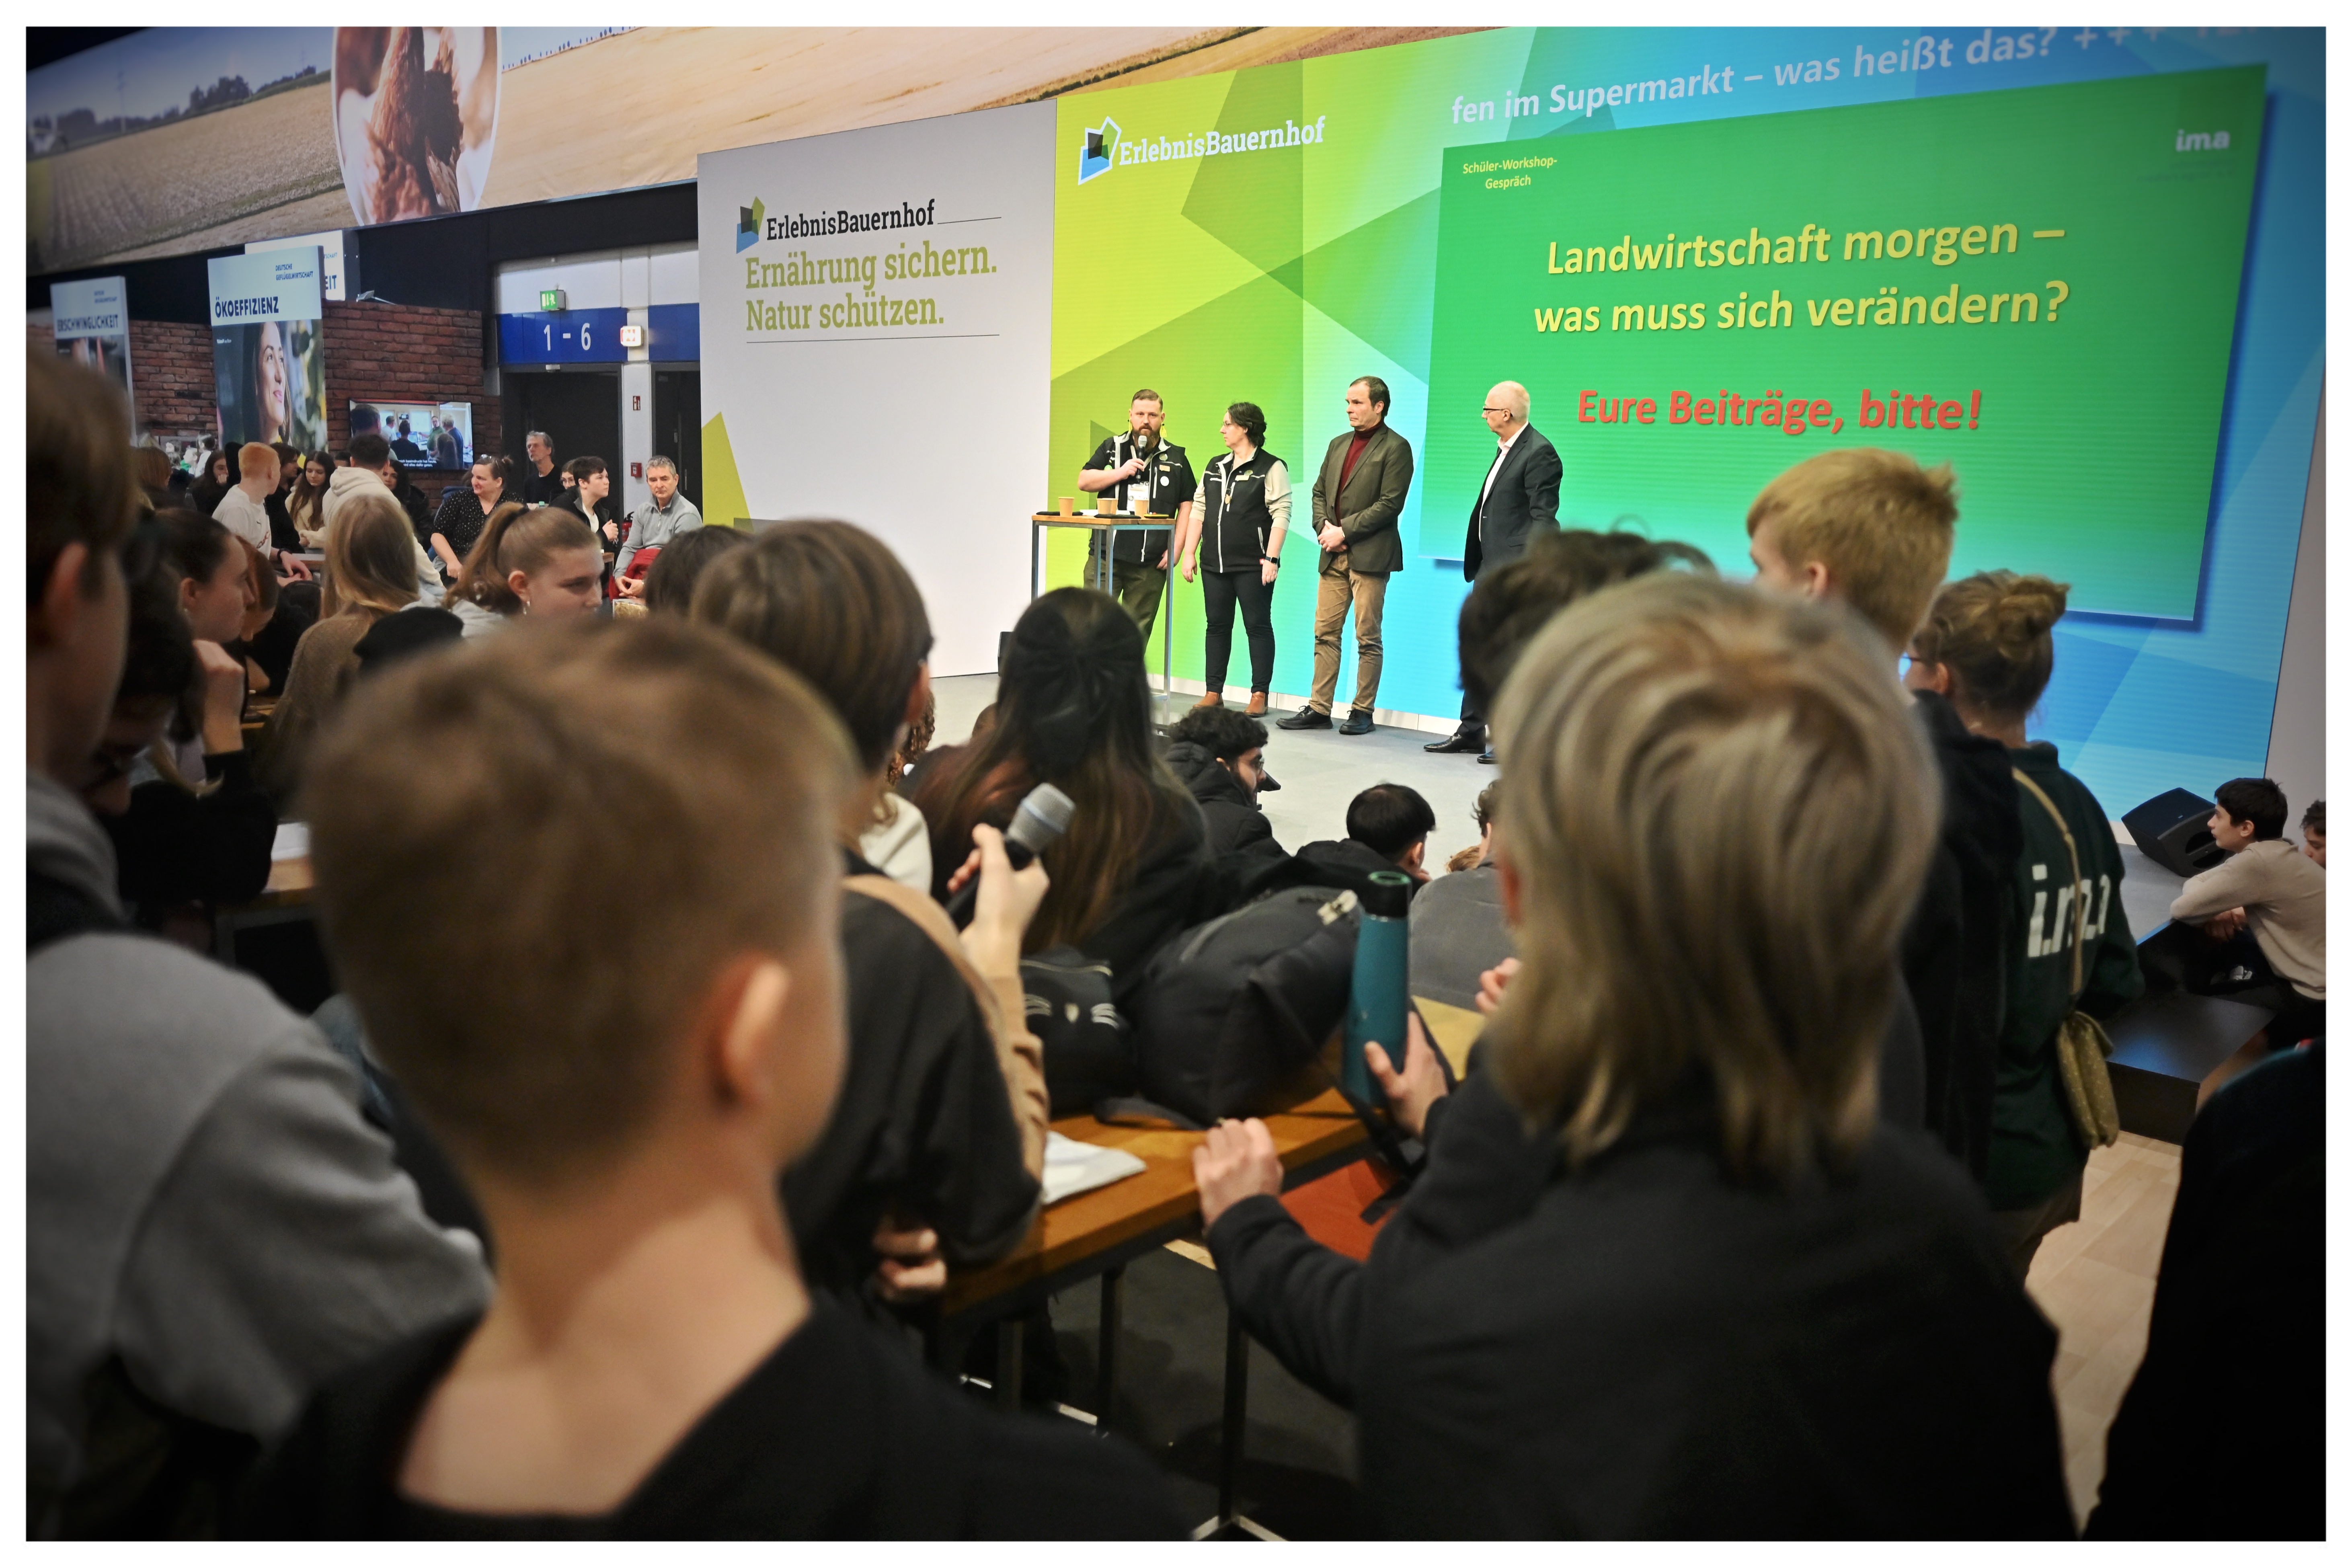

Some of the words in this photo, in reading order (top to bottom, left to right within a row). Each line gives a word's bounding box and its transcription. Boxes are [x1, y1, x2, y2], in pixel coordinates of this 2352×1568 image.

[1452, 96, 1494, 124] fen
[1504, 90, 1539, 118] im
[1550, 64, 1734, 117] Supermarkt
[1774, 57, 1840, 86] was
[1854, 35, 1953, 78] heißt
[1966, 27, 2057, 64] das?
[1119, 115, 1325, 165] ErlebnisBauernhof
[1462, 155, 1558, 174] Schüler-Workshop-
[1485, 174, 1531, 191] Gespräch
[767, 199, 935, 240] ErlebnisBauernhof
[745, 251, 877, 291] Ernährung
[885, 240, 997, 280] sichern.
[1548, 224, 1830, 274] Landwirtschaft
[1844, 222, 2018, 266] morgen
[276, 271, 313, 281] GEFLÜGELWIRTSCHAFT
[57, 314, 118, 332] ERSCHWINGLICHKEIT
[215, 296, 279, 318] ÖKOEFFIZIENZ
[746, 300, 812, 331] Natur
[819, 291, 944, 329] schützen.
[1534, 306, 1600, 332] was
[1612, 303, 1705, 330] muss
[1718, 289, 1793, 328] sich
[1807, 280, 2069, 326] verändern?
[544, 324, 551, 351] 1
[581, 322, 591, 351] 6
[1578, 390, 1656, 423] Eure
[1669, 389, 1843, 435] Beiträge,
[1859, 389, 1981, 429] bitte!
